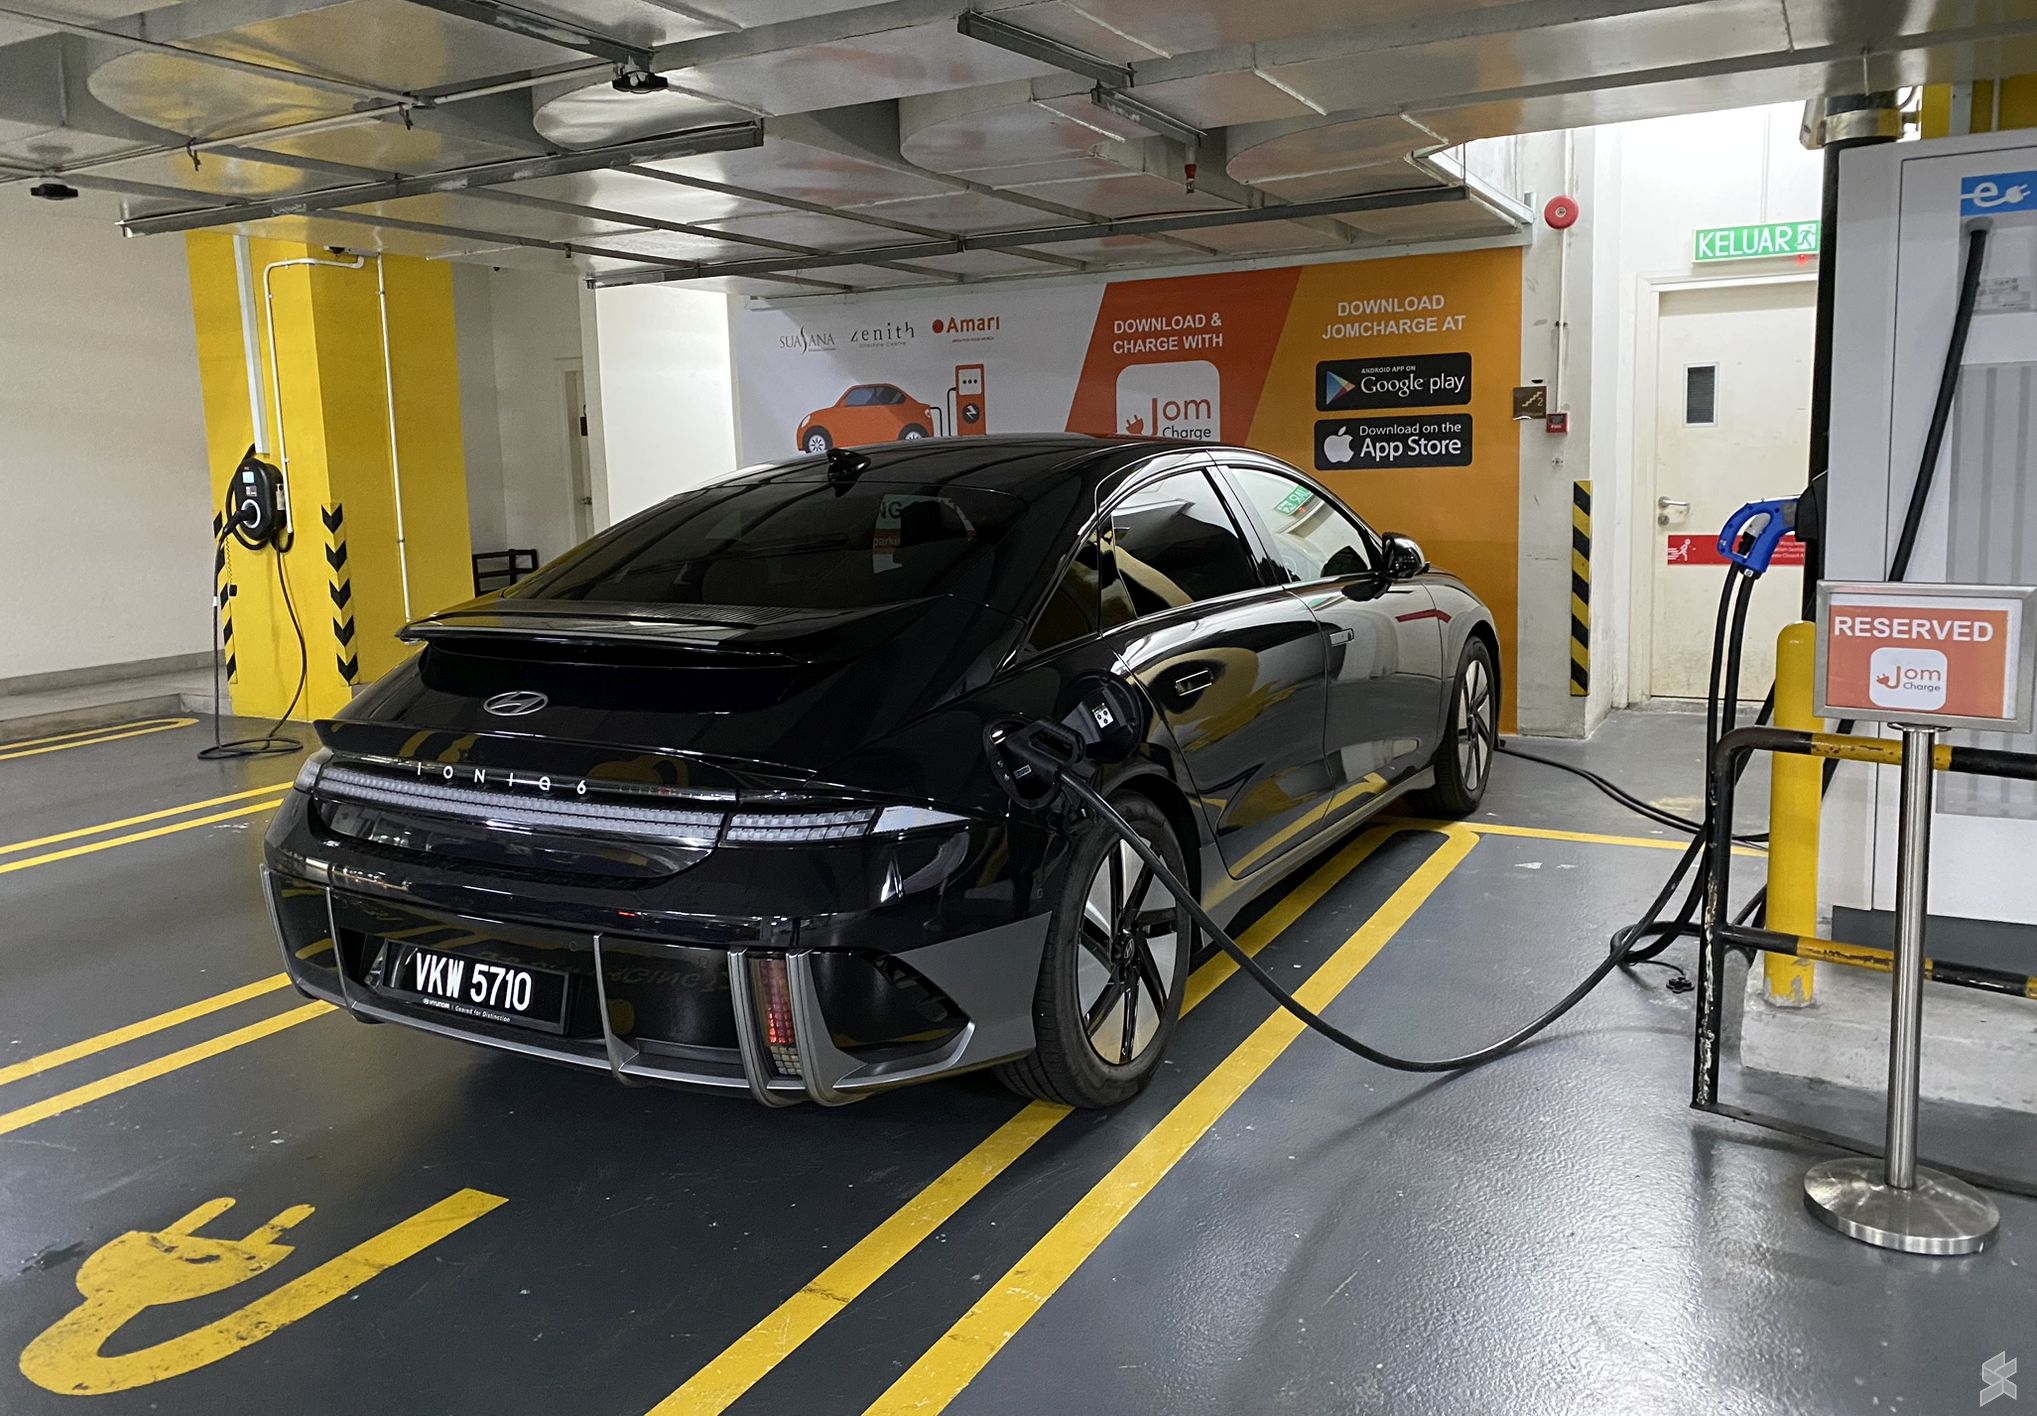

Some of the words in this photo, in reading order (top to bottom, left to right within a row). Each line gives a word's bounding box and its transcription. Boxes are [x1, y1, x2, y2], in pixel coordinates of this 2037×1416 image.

[1698, 226, 1793, 258] KELUAR
[1337, 294, 1445, 317] DOWNLOAD
[946, 316, 1000, 333] Amari
[1114, 314, 1206, 334] DOWNLOAD
[1211, 312, 1222, 327] &
[1322, 317, 1438, 340] JOMCHARGE
[1442, 315, 1466, 331] AT
[1113, 336, 1179, 354] CHARGE
[1182, 333, 1223, 349] WITH
[1360, 373, 1424, 398] Google
[1429, 373, 1466, 394] play
[1359, 423, 1420, 436] Download
[1422, 425, 1438, 433] on
[1441, 422, 1462, 432] the
[1360, 437, 1404, 462] App
[1407, 436, 1462, 456] Store
[1834, 616, 1994, 642] RESERVED
[1877, 665, 1941, 690] Jom
[1903, 682, 1941, 693] Charge
[417, 761, 551, 792] IONIQ
[576, 779, 587, 795] 6
[416, 952, 465, 999] VKW
[469, 963, 532, 1012] 5710
